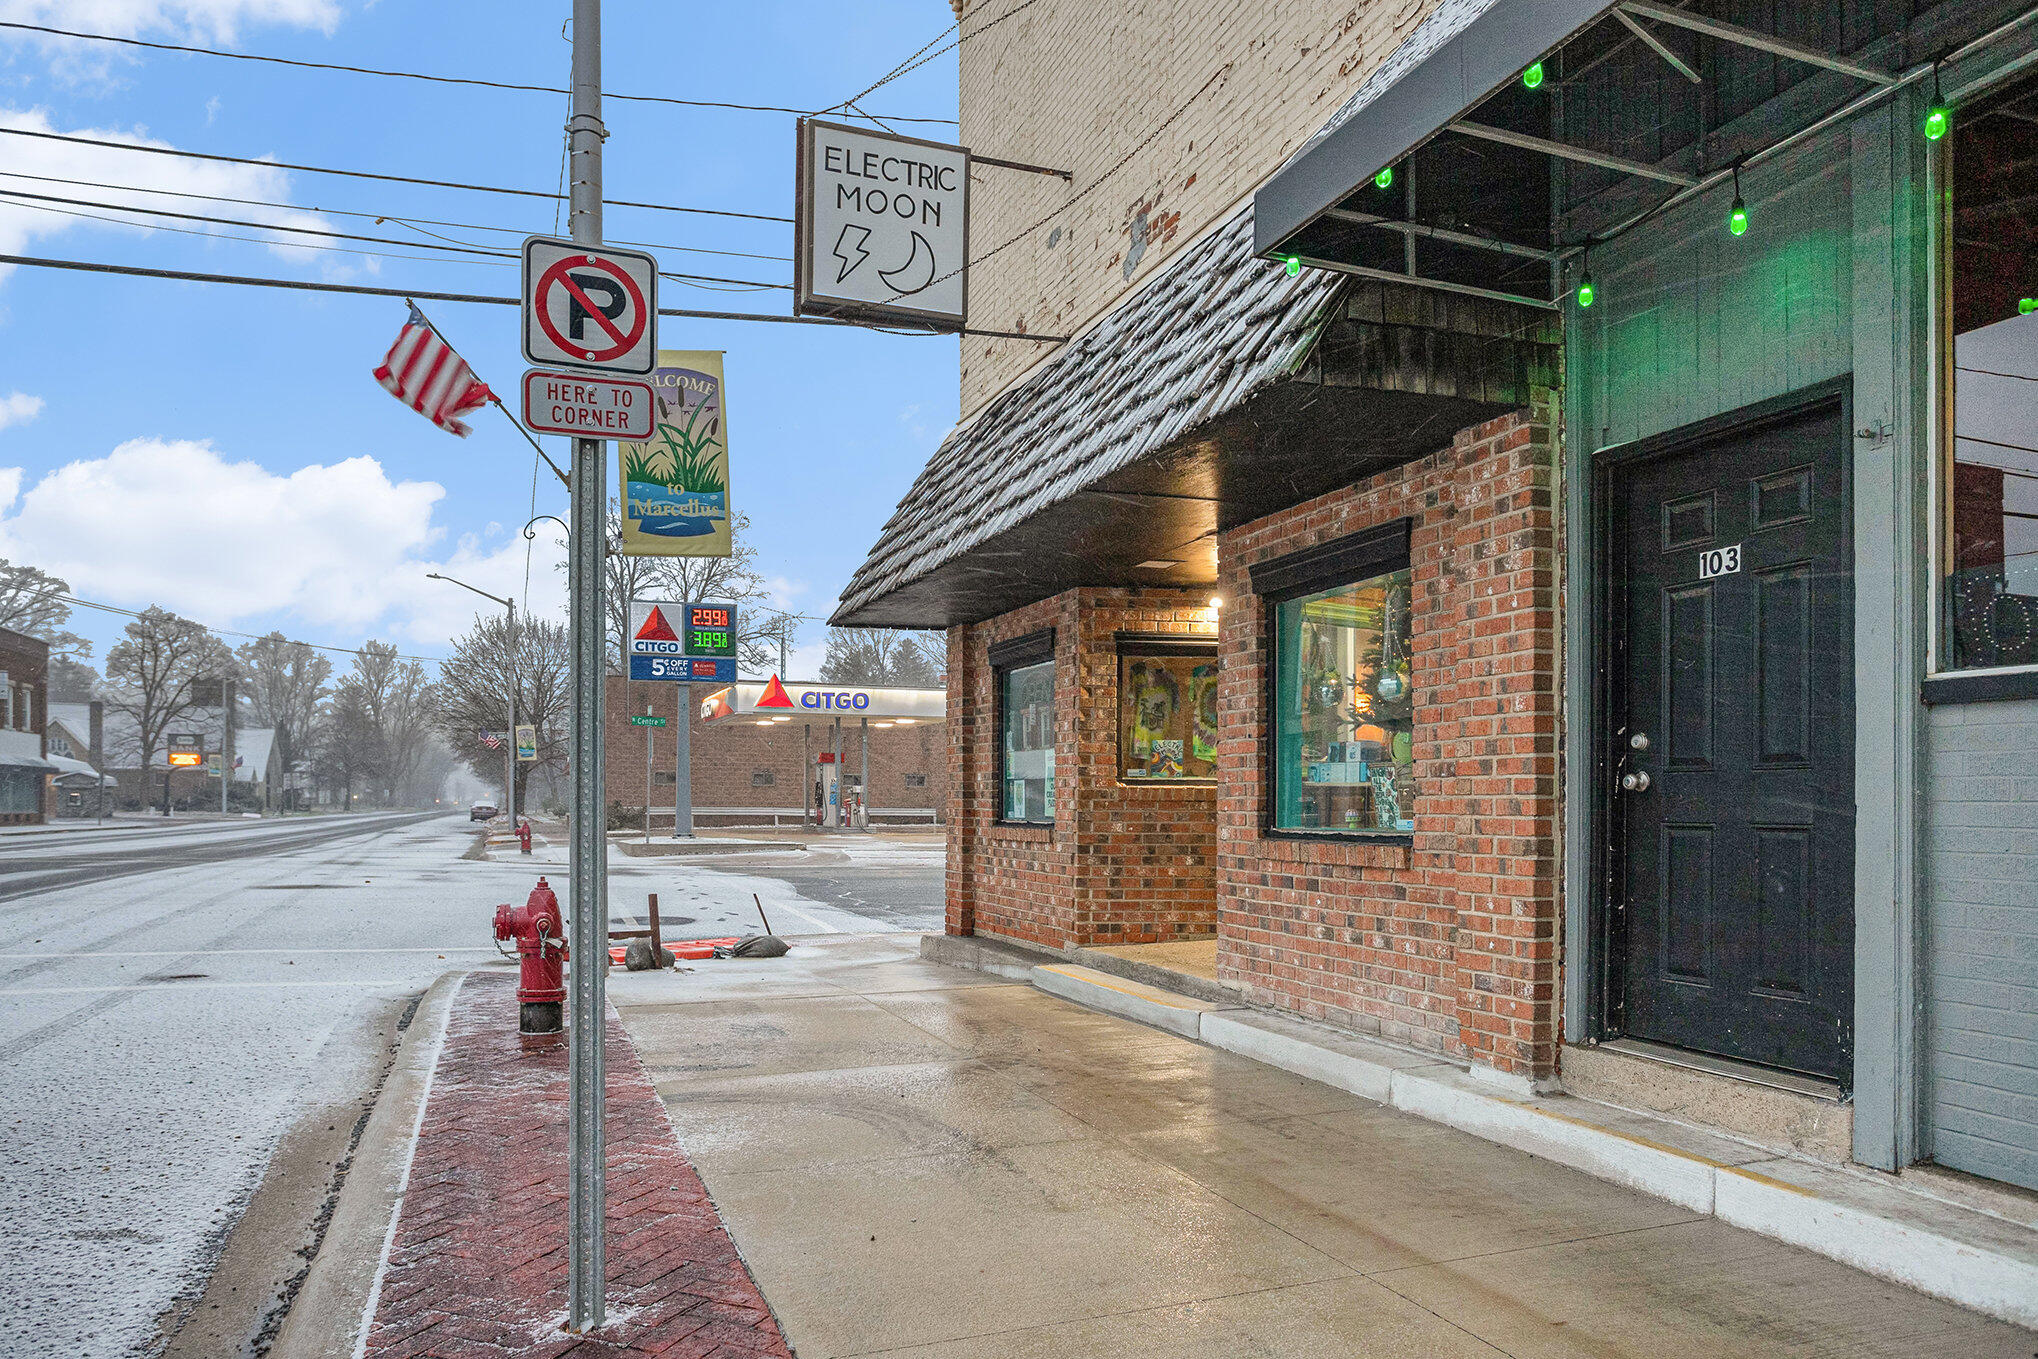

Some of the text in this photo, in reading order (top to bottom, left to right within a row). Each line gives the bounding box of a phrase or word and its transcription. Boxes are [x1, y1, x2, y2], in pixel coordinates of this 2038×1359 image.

[824, 145, 957, 192] ELECTRIC
[836, 182, 941, 228] MOON
[546, 382, 633, 408] HERE TO
[650, 374, 716, 396] LCOME
[551, 405, 630, 430] CORNER
[666, 481, 685, 496] to
[633, 498, 720, 517] Marcellus
[1700, 547, 1739, 577] 103
[634, 641, 679, 653] CITGO
[670, 659, 689, 668] OFF
[800, 691, 870, 710] CITGO
